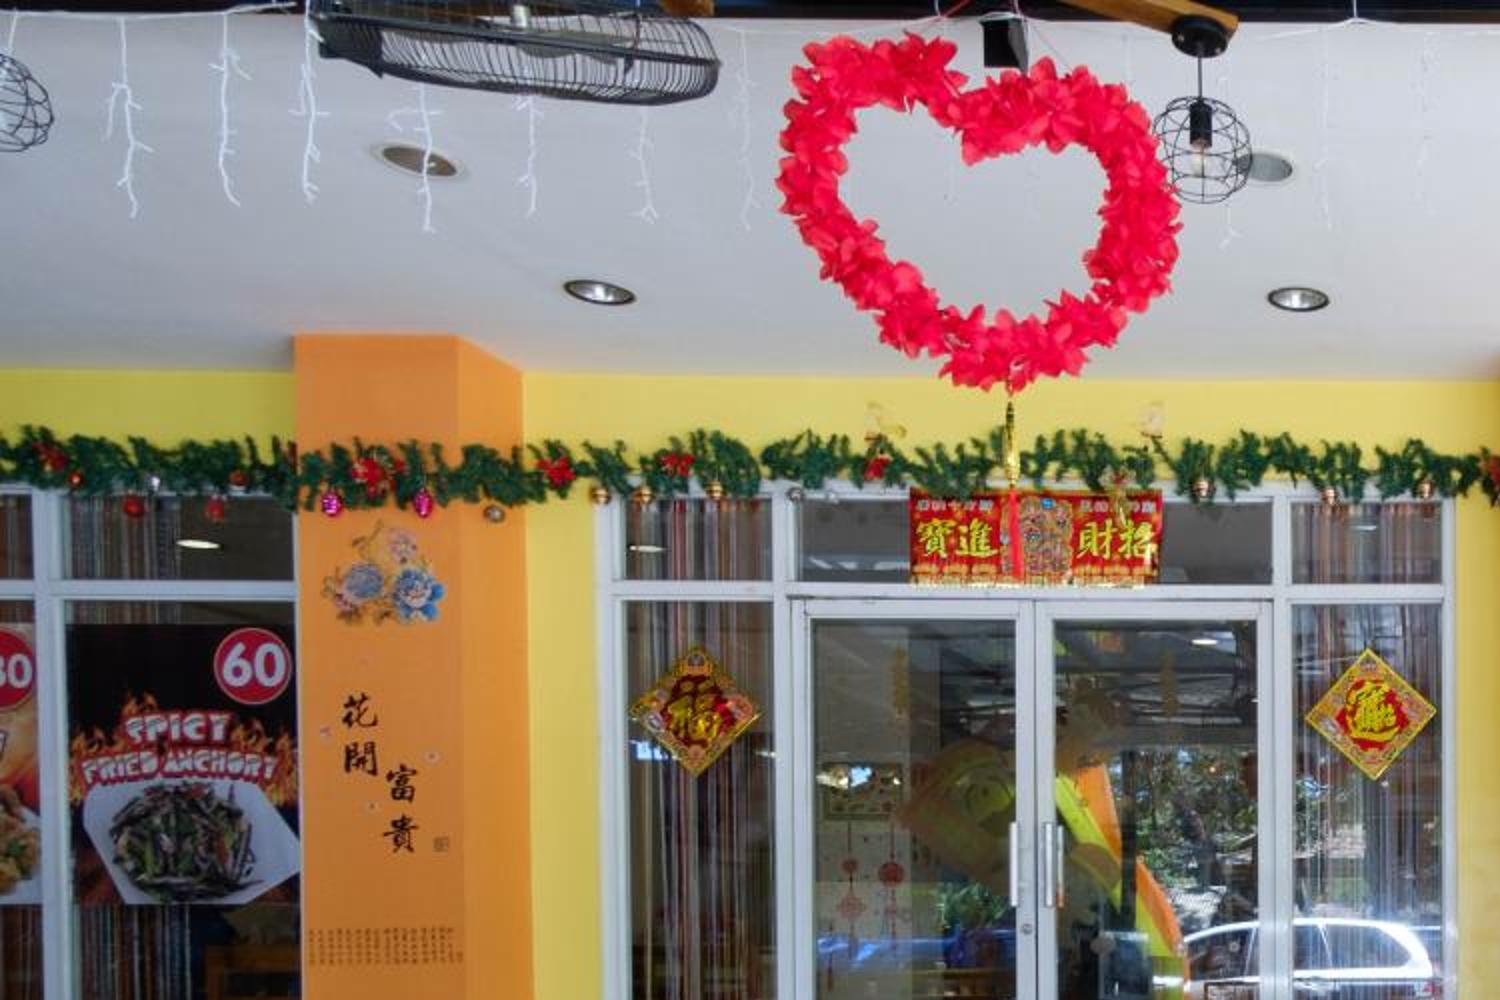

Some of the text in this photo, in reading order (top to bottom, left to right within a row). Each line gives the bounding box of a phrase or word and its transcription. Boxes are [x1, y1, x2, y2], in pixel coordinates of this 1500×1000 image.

[223, 642, 286, 687] 60
[126, 713, 231, 745] SPICY
[82, 751, 159, 784] FRIED
